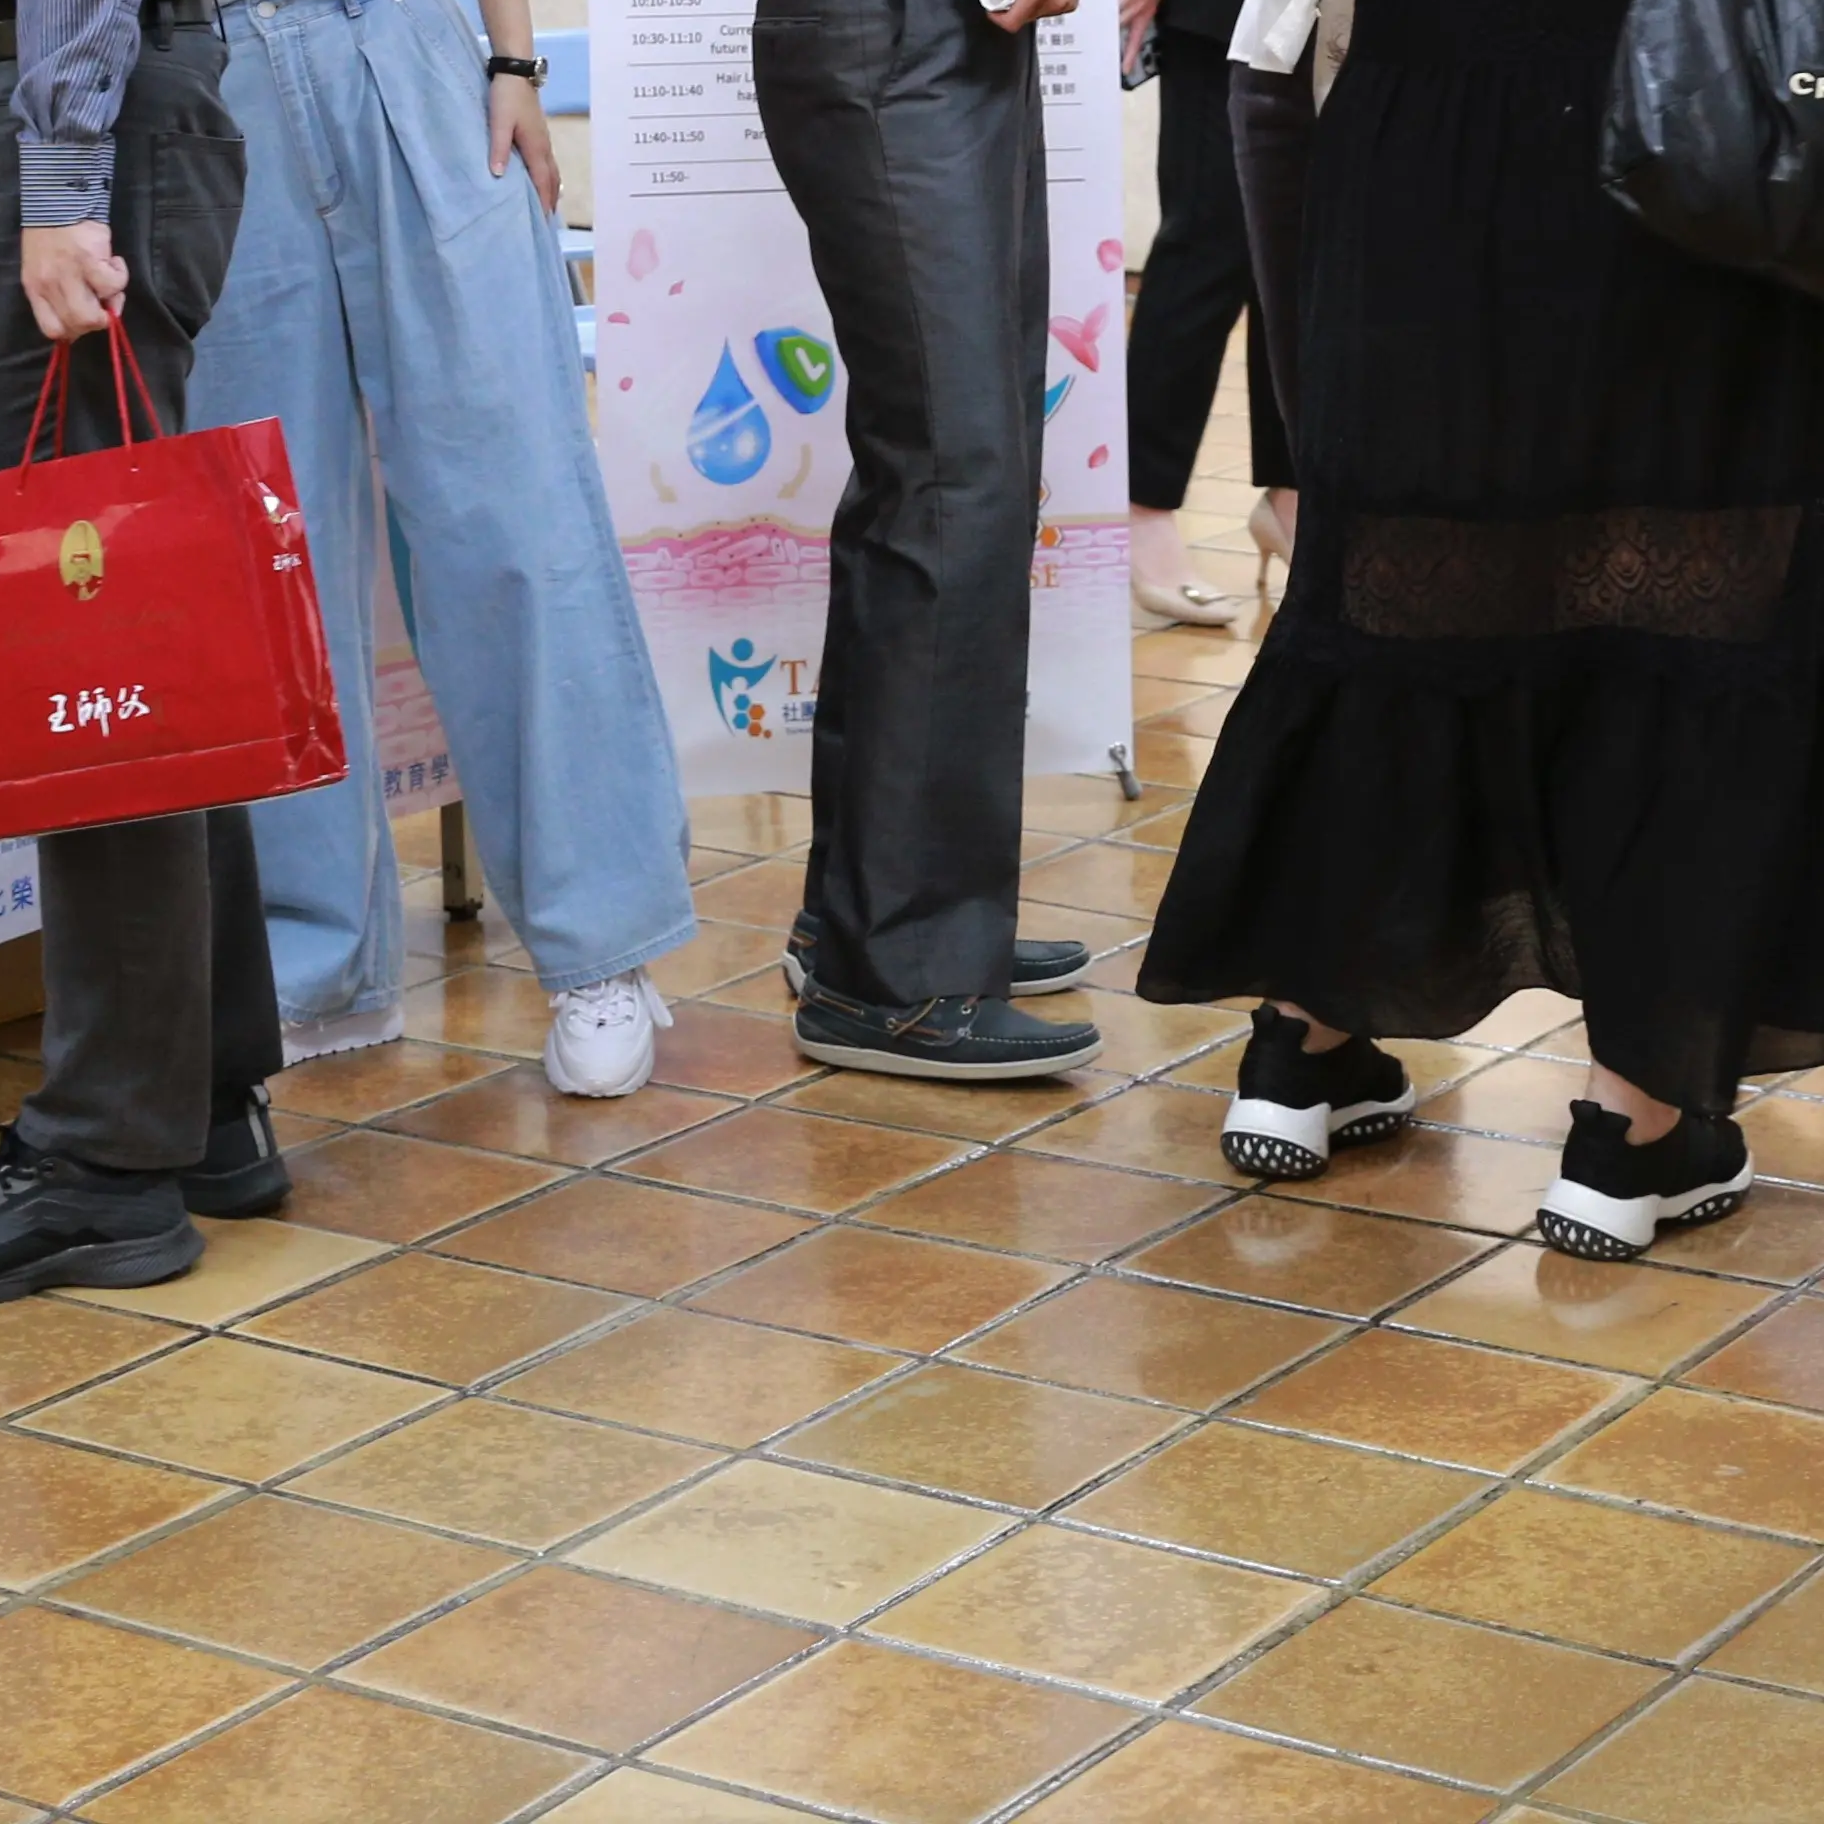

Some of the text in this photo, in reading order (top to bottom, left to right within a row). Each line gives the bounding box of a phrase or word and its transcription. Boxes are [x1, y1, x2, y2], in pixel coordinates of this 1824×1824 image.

[720, 25, 753, 36] Curre
[632, 32, 703, 46] 10:30-11:10
[711, 42, 748, 54] future
[717, 72, 742, 84] Hair
[633, 85, 704, 98] 11:10-11:40
[634, 130, 705, 144] 11:40-11:50
[47, 684, 151, 738] 王師父
